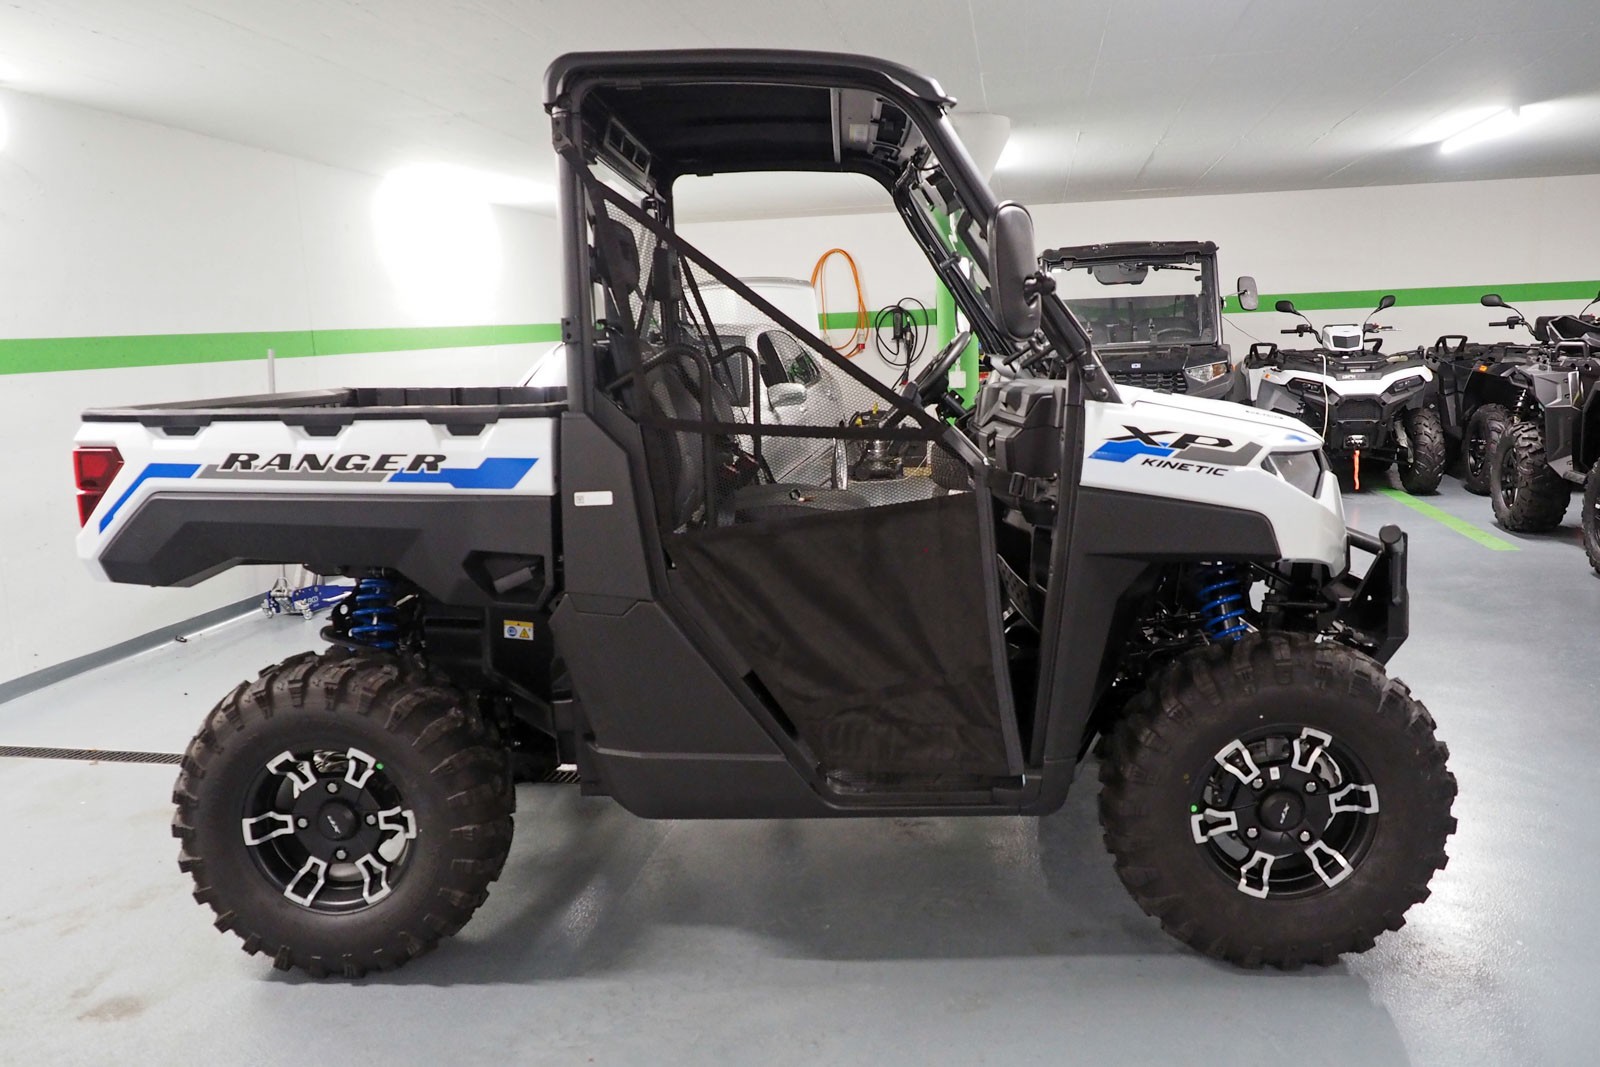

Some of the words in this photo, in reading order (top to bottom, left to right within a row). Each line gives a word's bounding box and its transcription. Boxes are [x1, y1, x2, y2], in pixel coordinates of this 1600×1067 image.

[1103, 424, 1233, 449] XP
[217, 453, 446, 472] RANGER
[1141, 458, 1228, 476] KINETIC
